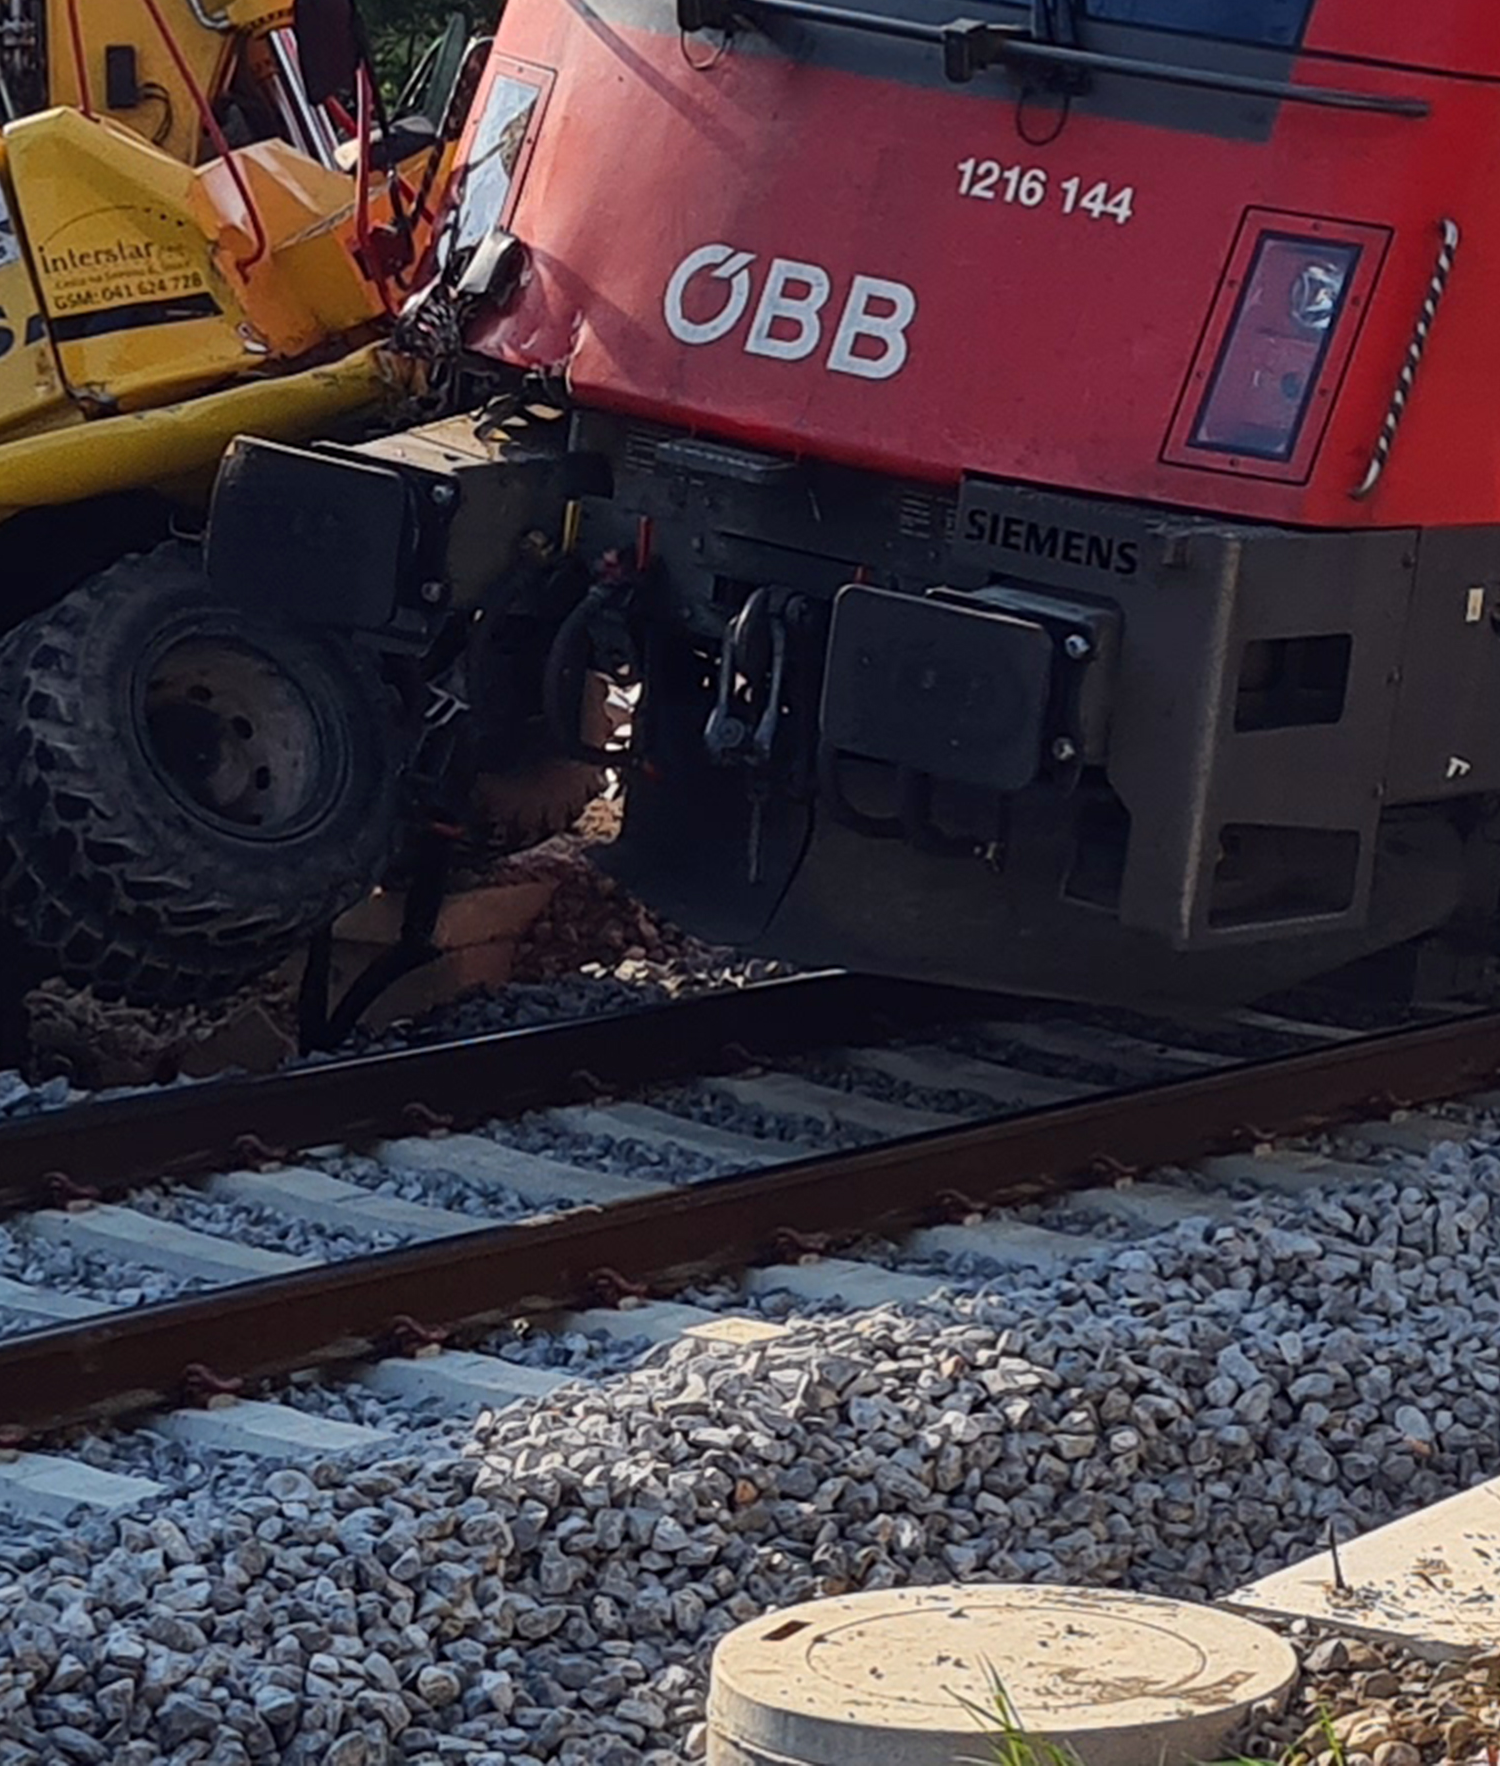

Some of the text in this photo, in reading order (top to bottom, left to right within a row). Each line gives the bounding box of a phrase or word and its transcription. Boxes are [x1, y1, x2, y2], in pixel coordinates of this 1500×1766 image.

[957, 157, 1133, 225] 1216 144
[54, 290, 99, 311] GSM:
[101, 284, 134, 302] 041
[663, 243, 916, 380] ÖBB
[964, 508, 1138, 575] SIEMENS
